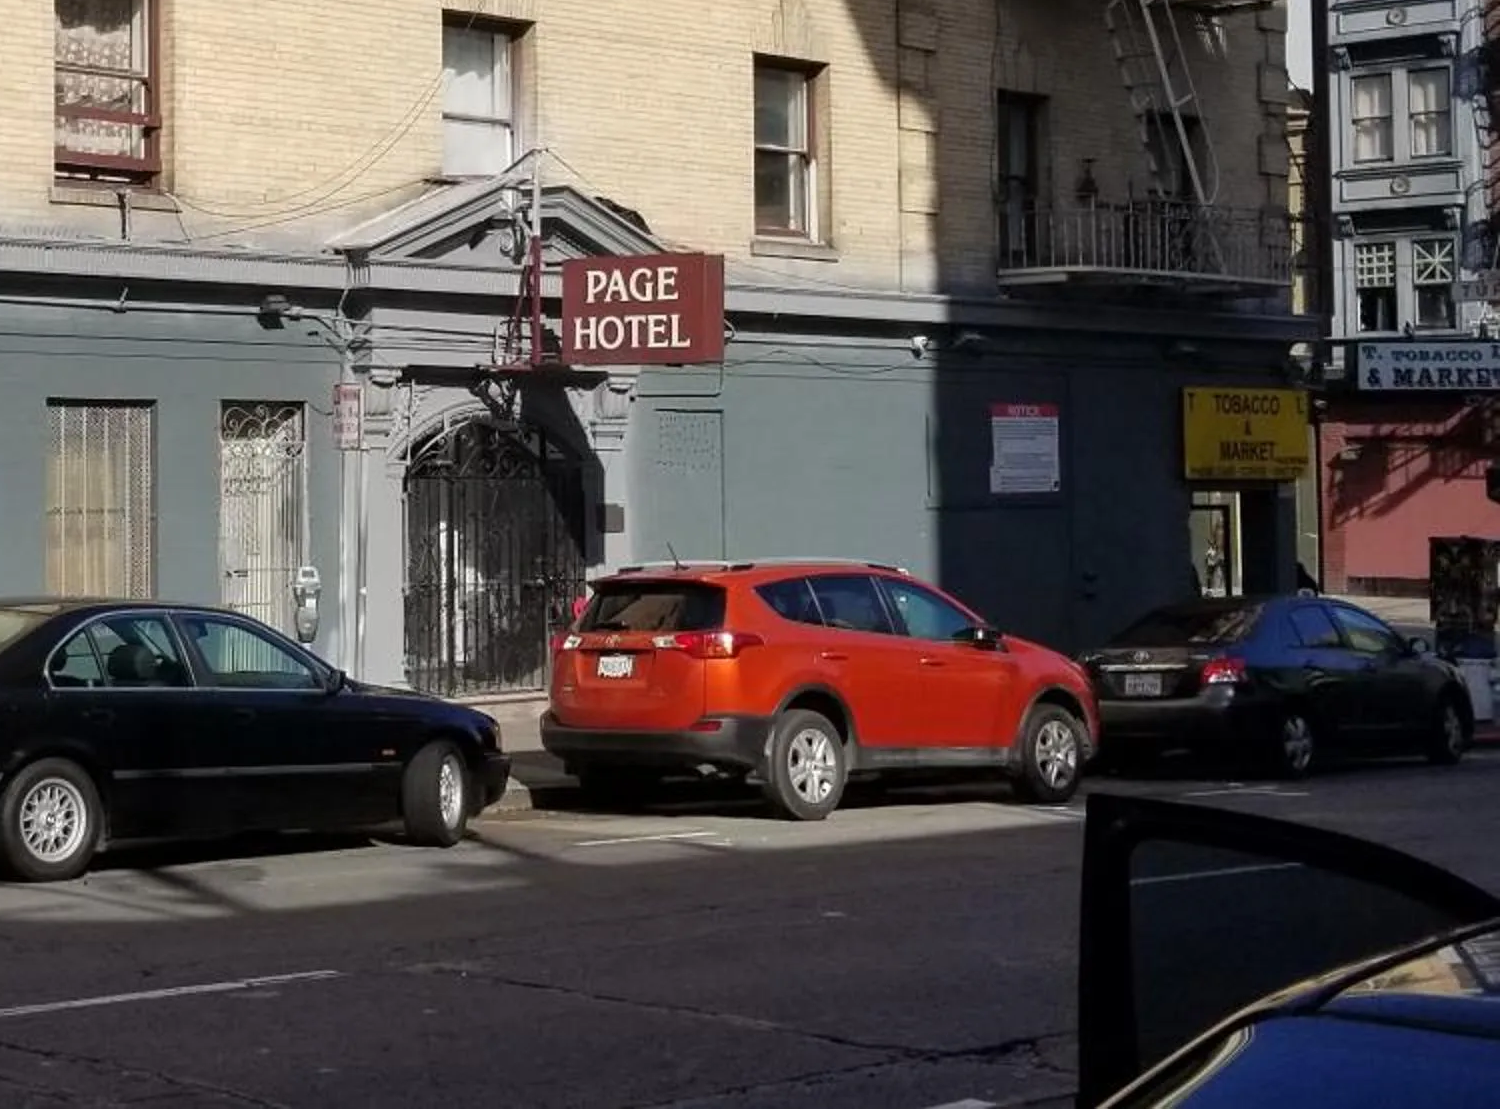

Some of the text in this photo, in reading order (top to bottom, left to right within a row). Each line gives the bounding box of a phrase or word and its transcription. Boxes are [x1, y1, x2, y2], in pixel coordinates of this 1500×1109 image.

[585, 266, 679, 303] PAGE
[574, 314, 690, 350] HOTEL
[1391, 349, 1483, 362] TOBACCO
[1367, 367, 1382, 387] &
[1214, 394, 1281, 415] TOBACCO
[1219, 441, 1276, 461] MARKET
